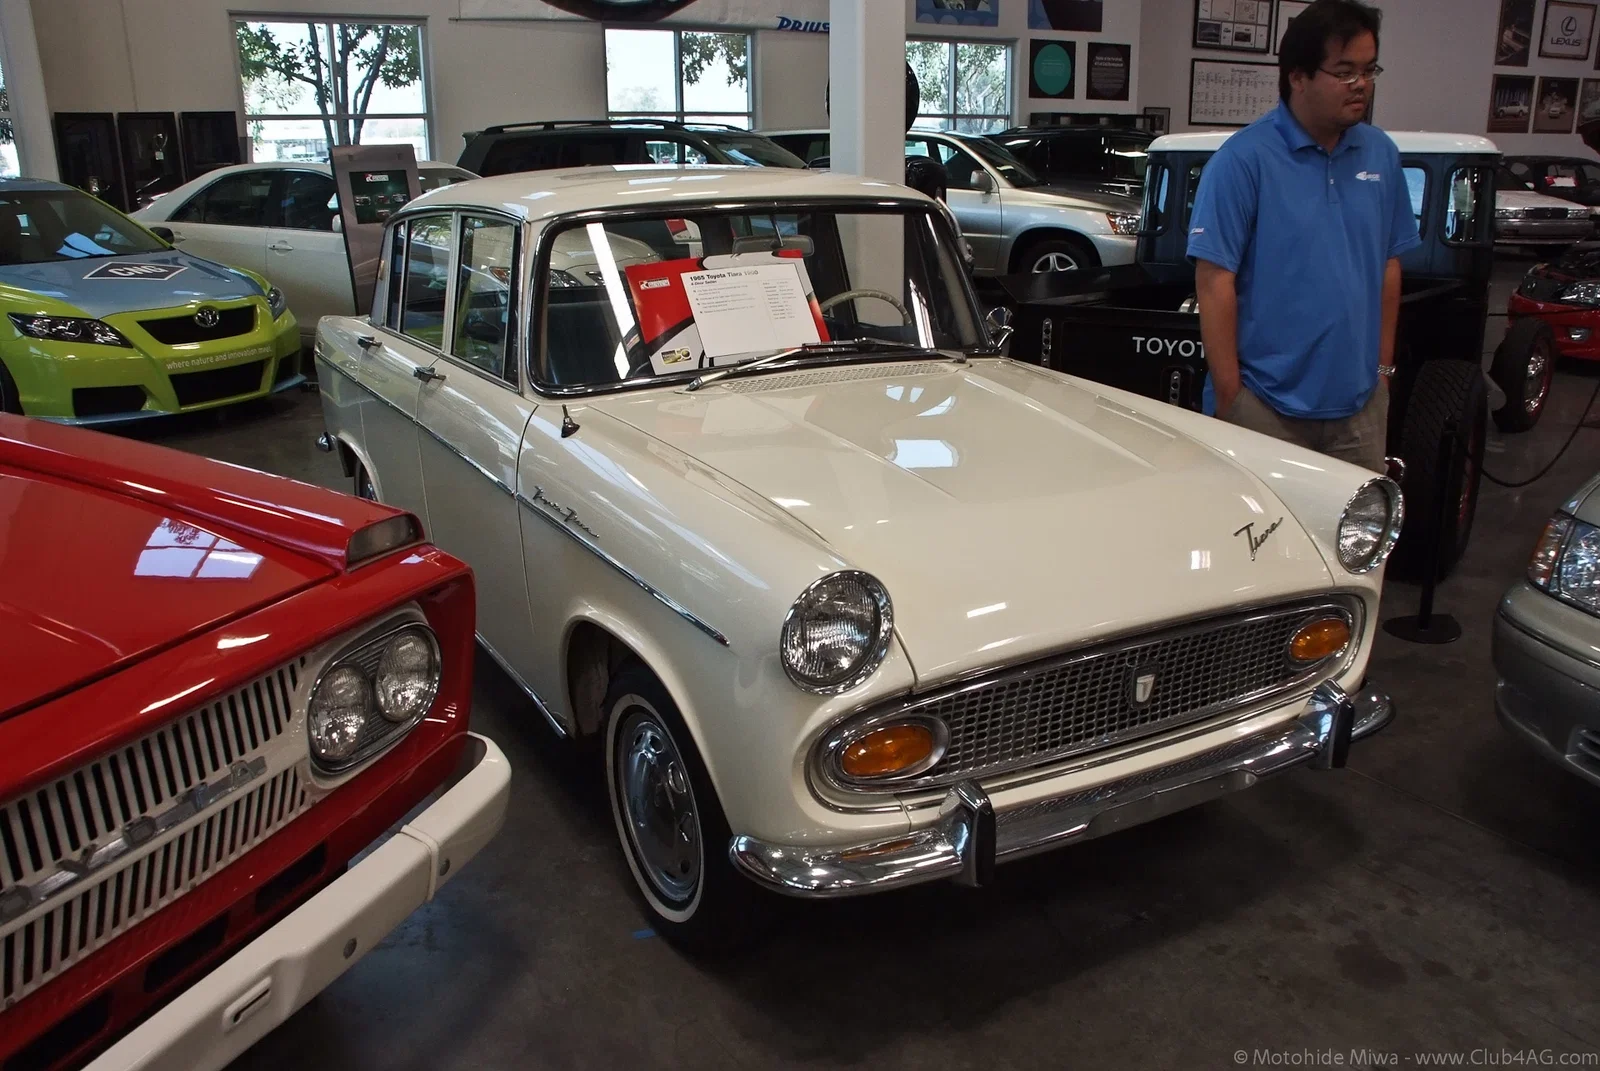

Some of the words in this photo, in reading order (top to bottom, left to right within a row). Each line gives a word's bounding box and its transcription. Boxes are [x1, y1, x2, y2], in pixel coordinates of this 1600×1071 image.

[1550, 36, 1581, 46] LEXUS
[166, 360, 190, 370] where
[191, 357, 214, 366] nature
[215, 354, 227, 362] and
[228, 348, 258, 359] innovation
